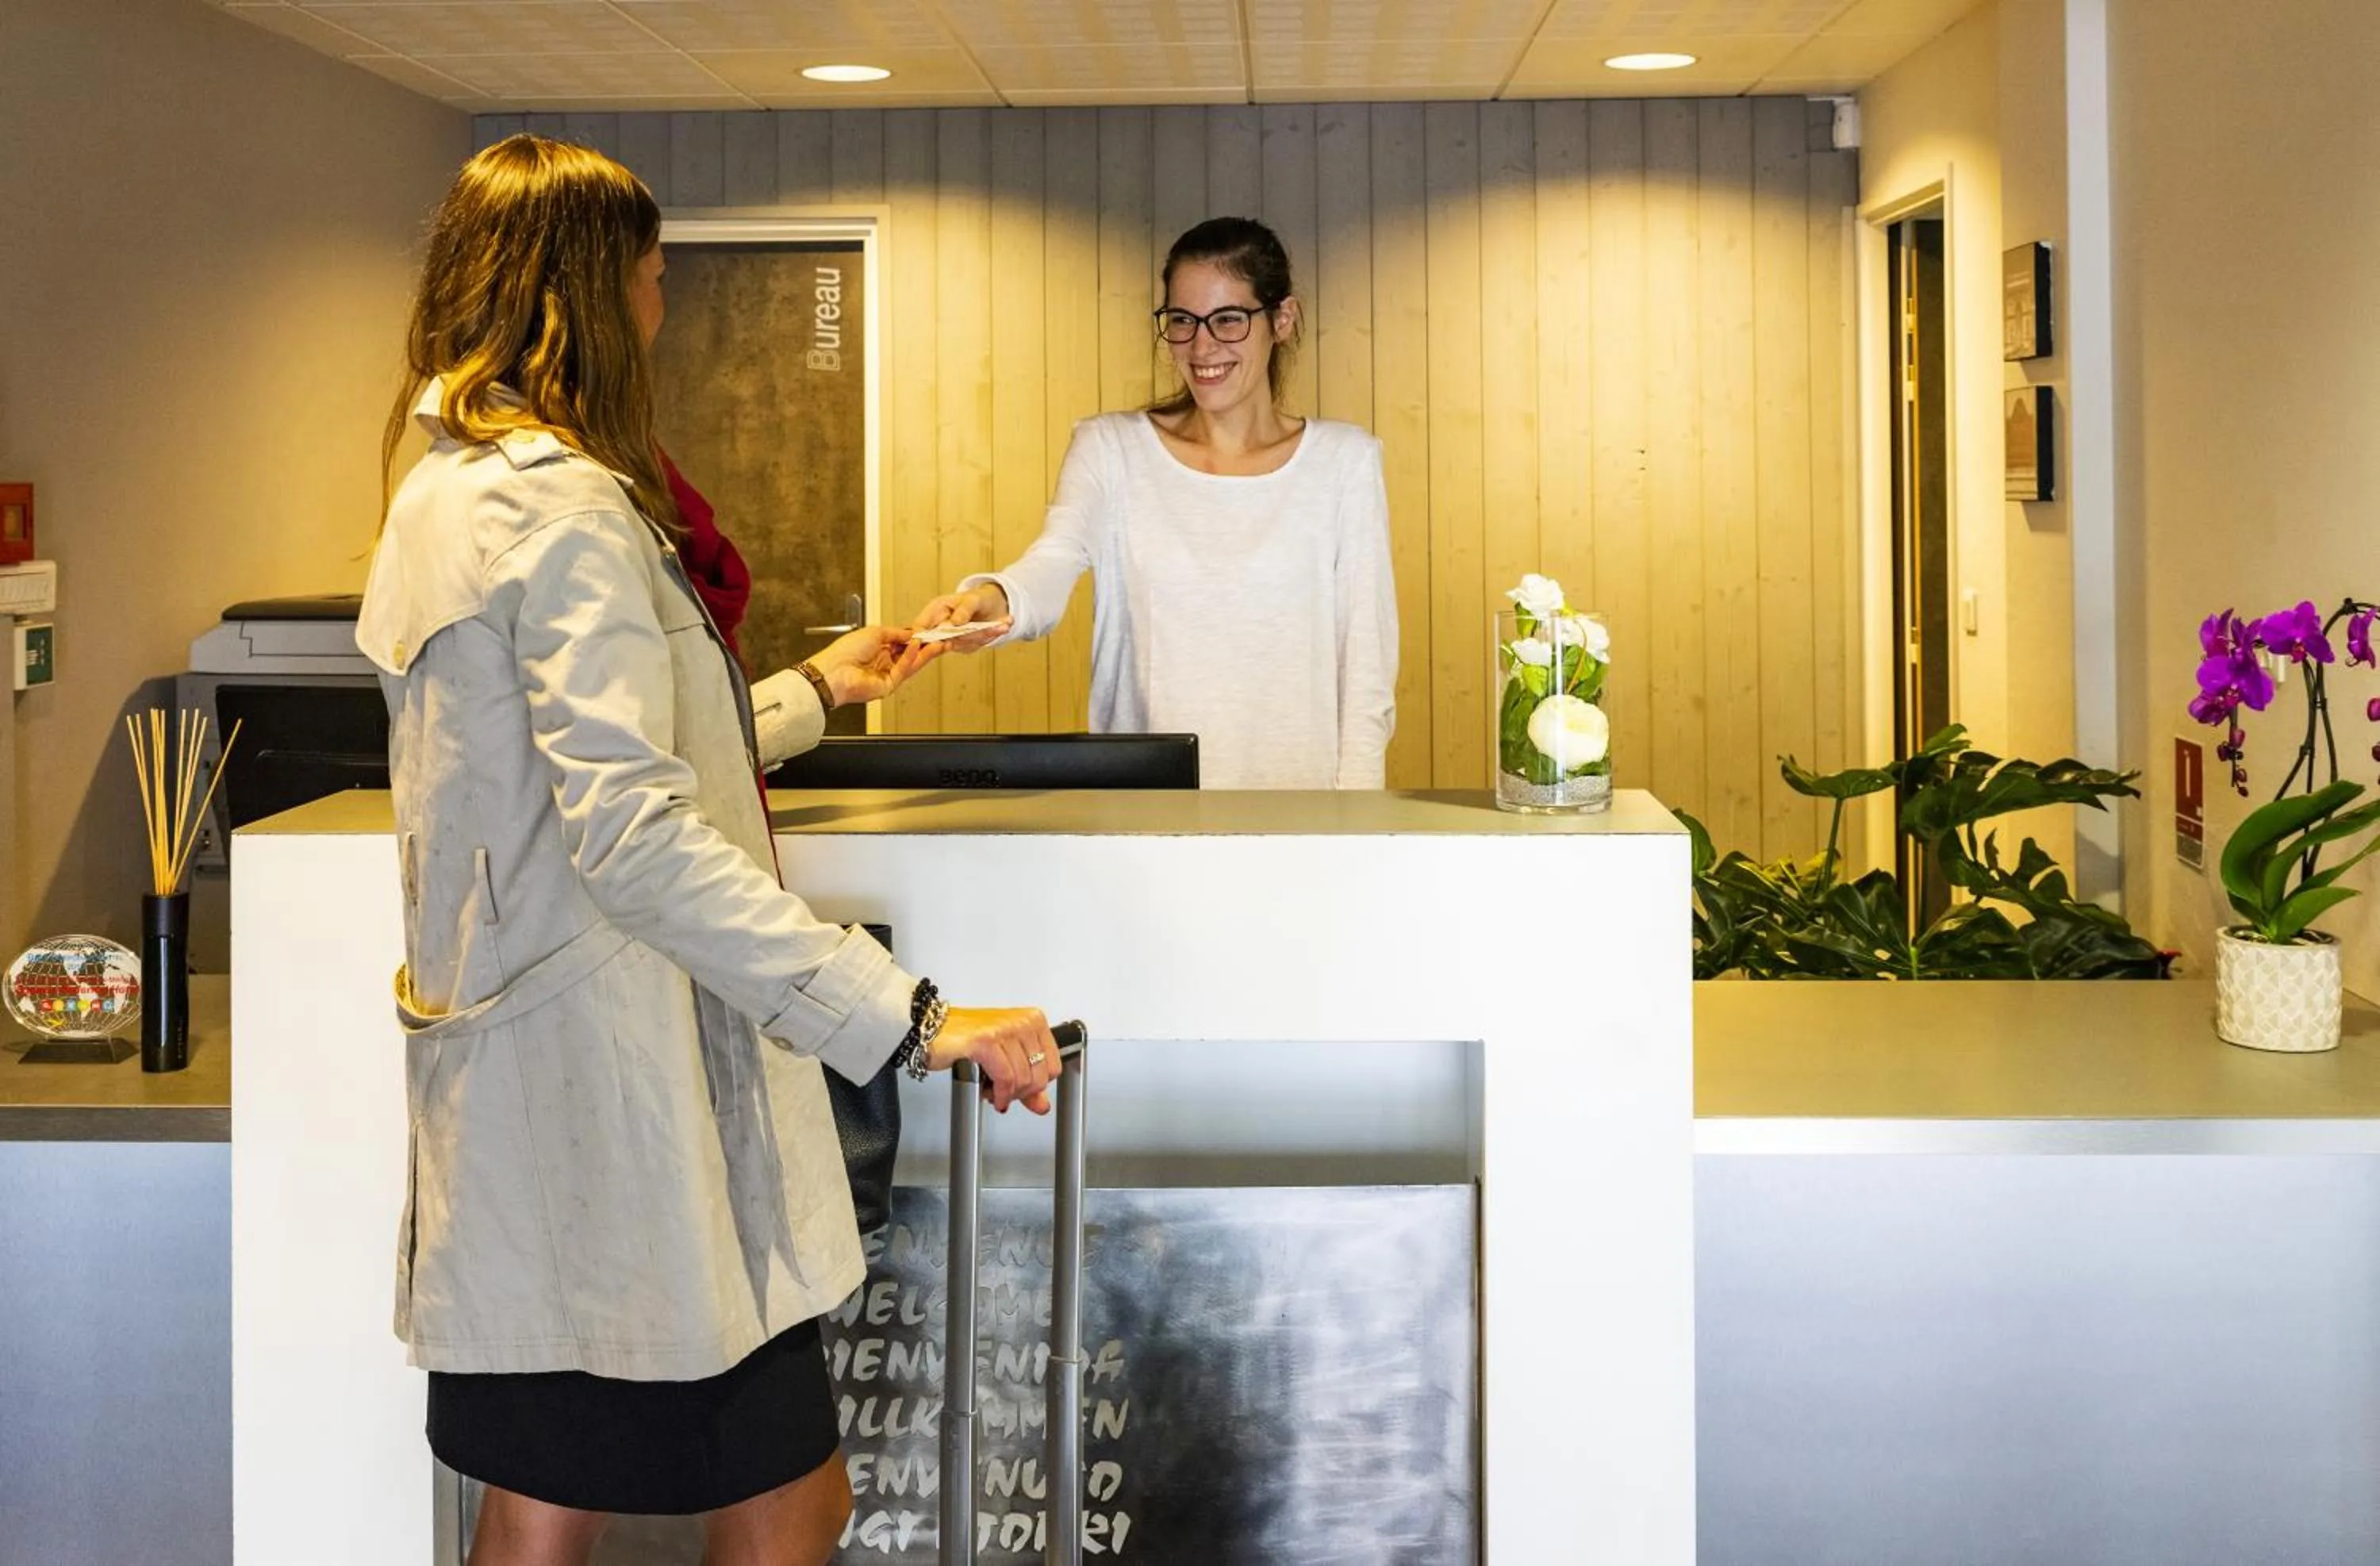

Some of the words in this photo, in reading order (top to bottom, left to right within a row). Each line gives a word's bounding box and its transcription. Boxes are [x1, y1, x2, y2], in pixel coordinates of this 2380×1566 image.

[806, 267, 841, 371] Bureau
[839, 1395, 1130, 1441] ILLKMMN
[846, 1453, 1123, 1502] ENVNUO
